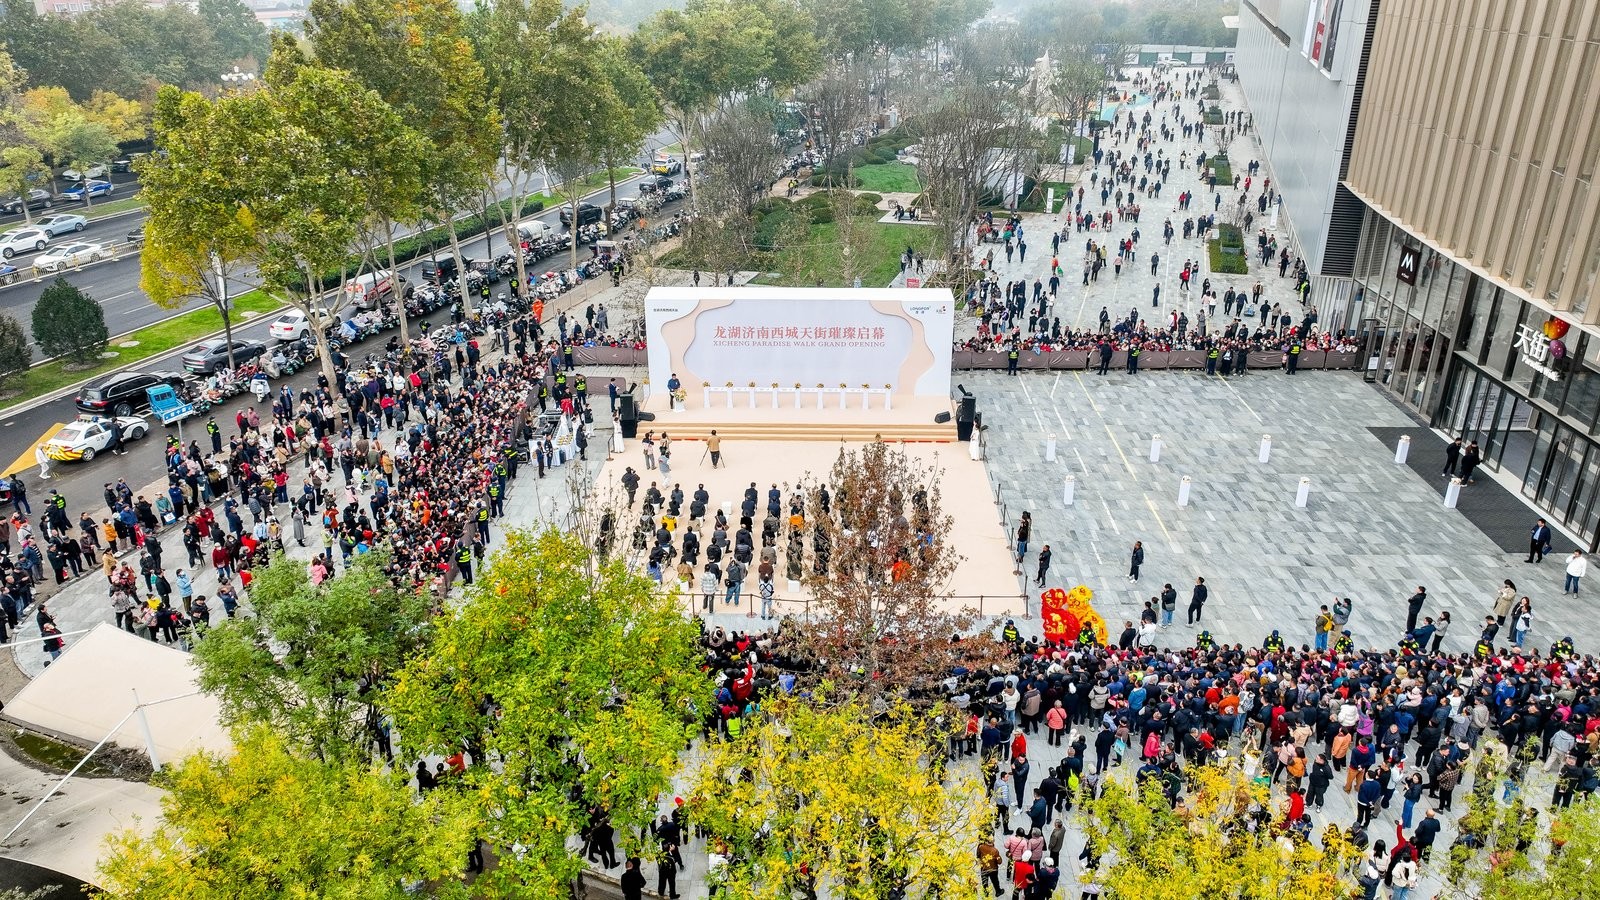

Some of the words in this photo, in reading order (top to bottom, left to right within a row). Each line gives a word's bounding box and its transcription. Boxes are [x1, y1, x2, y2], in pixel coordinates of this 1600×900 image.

[714, 325, 885, 339] 龙湖济南西城天街璀璨启幕
[1513, 323, 1551, 362] 天街
